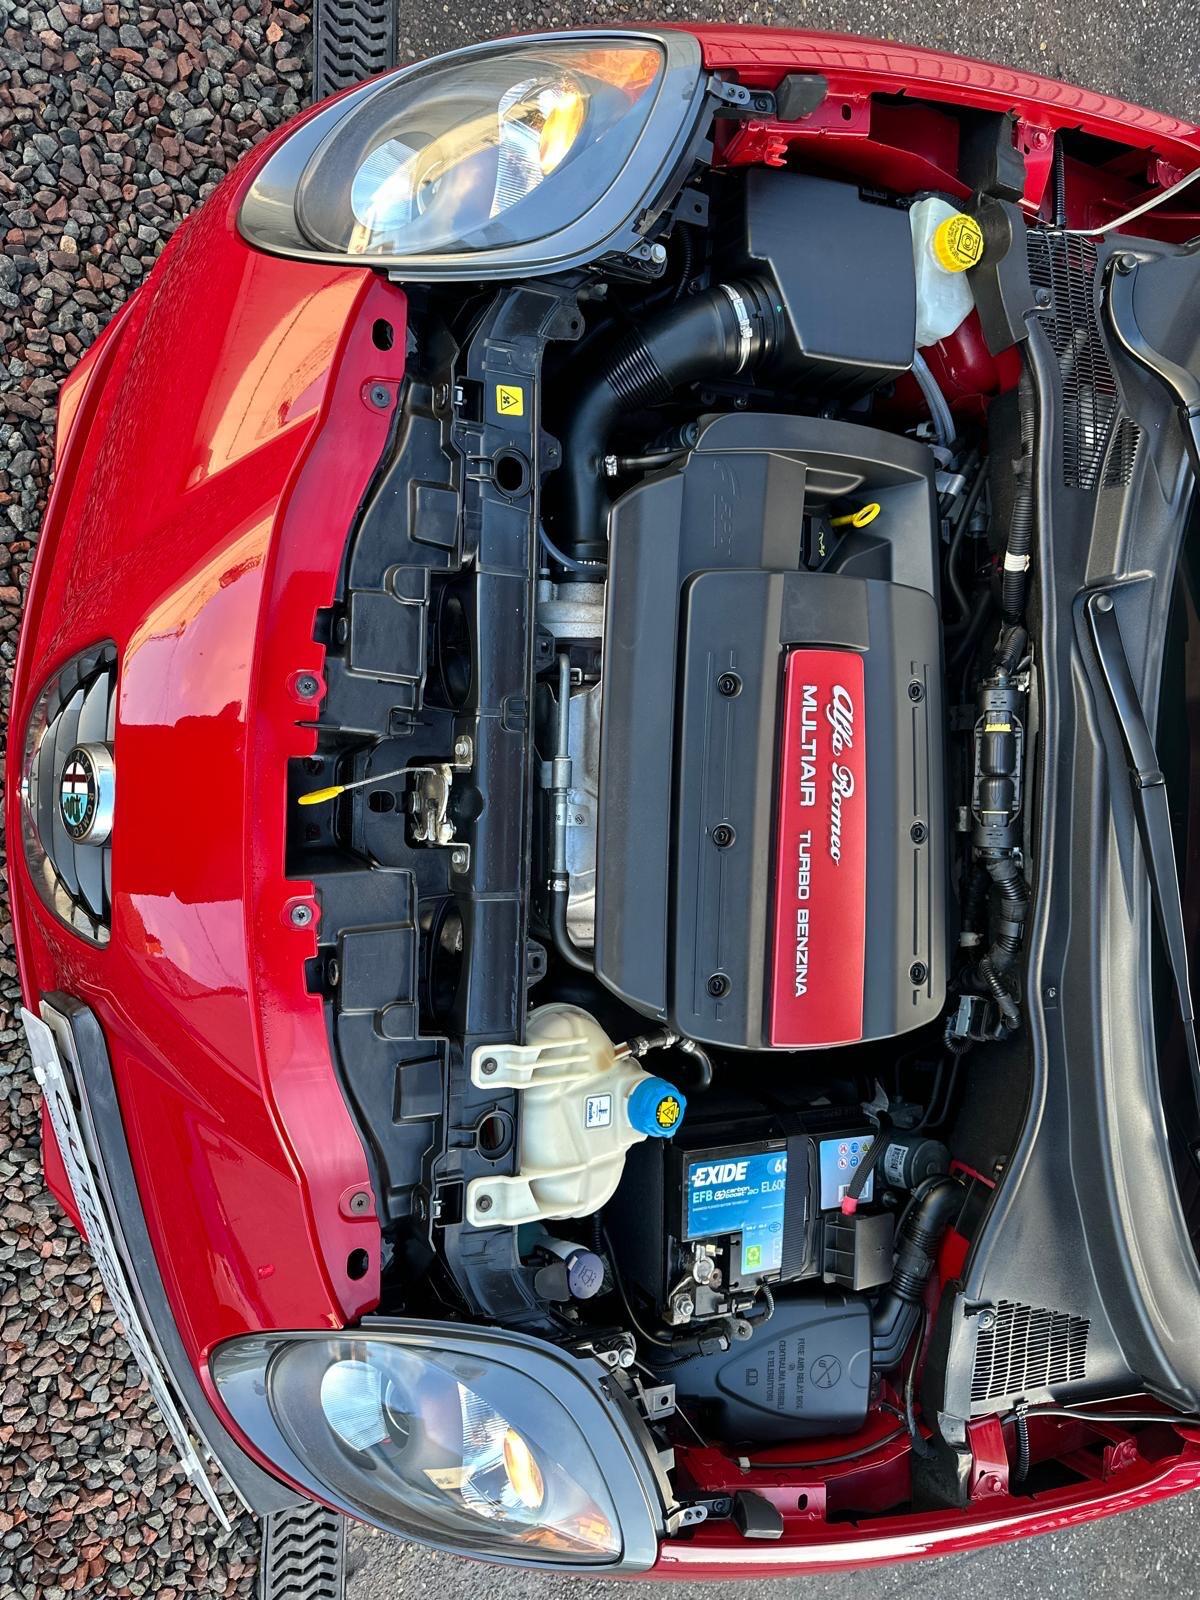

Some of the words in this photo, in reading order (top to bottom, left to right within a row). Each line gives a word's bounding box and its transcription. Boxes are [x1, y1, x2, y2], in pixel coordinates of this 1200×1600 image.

[825, 685, 854, 756] Alfa
[800, 685, 817, 806] MULTIAIR
[74, 752, 93, 783] ALFA
[72, 792, 95, 837] ROMEO
[830, 762, 854, 866] Romeo
[798, 830, 811, 900] TURBO
[795, 909, 809, 997] BENZINA
[691, 1162, 750, 1187] EXIDE
[692, 1190, 713, 1204] EFB
[797, 1338, 805, 1357] FUSE
[797, 1357, 805, 1371] AND
[796, 1372, 804, 1393] RELAY
